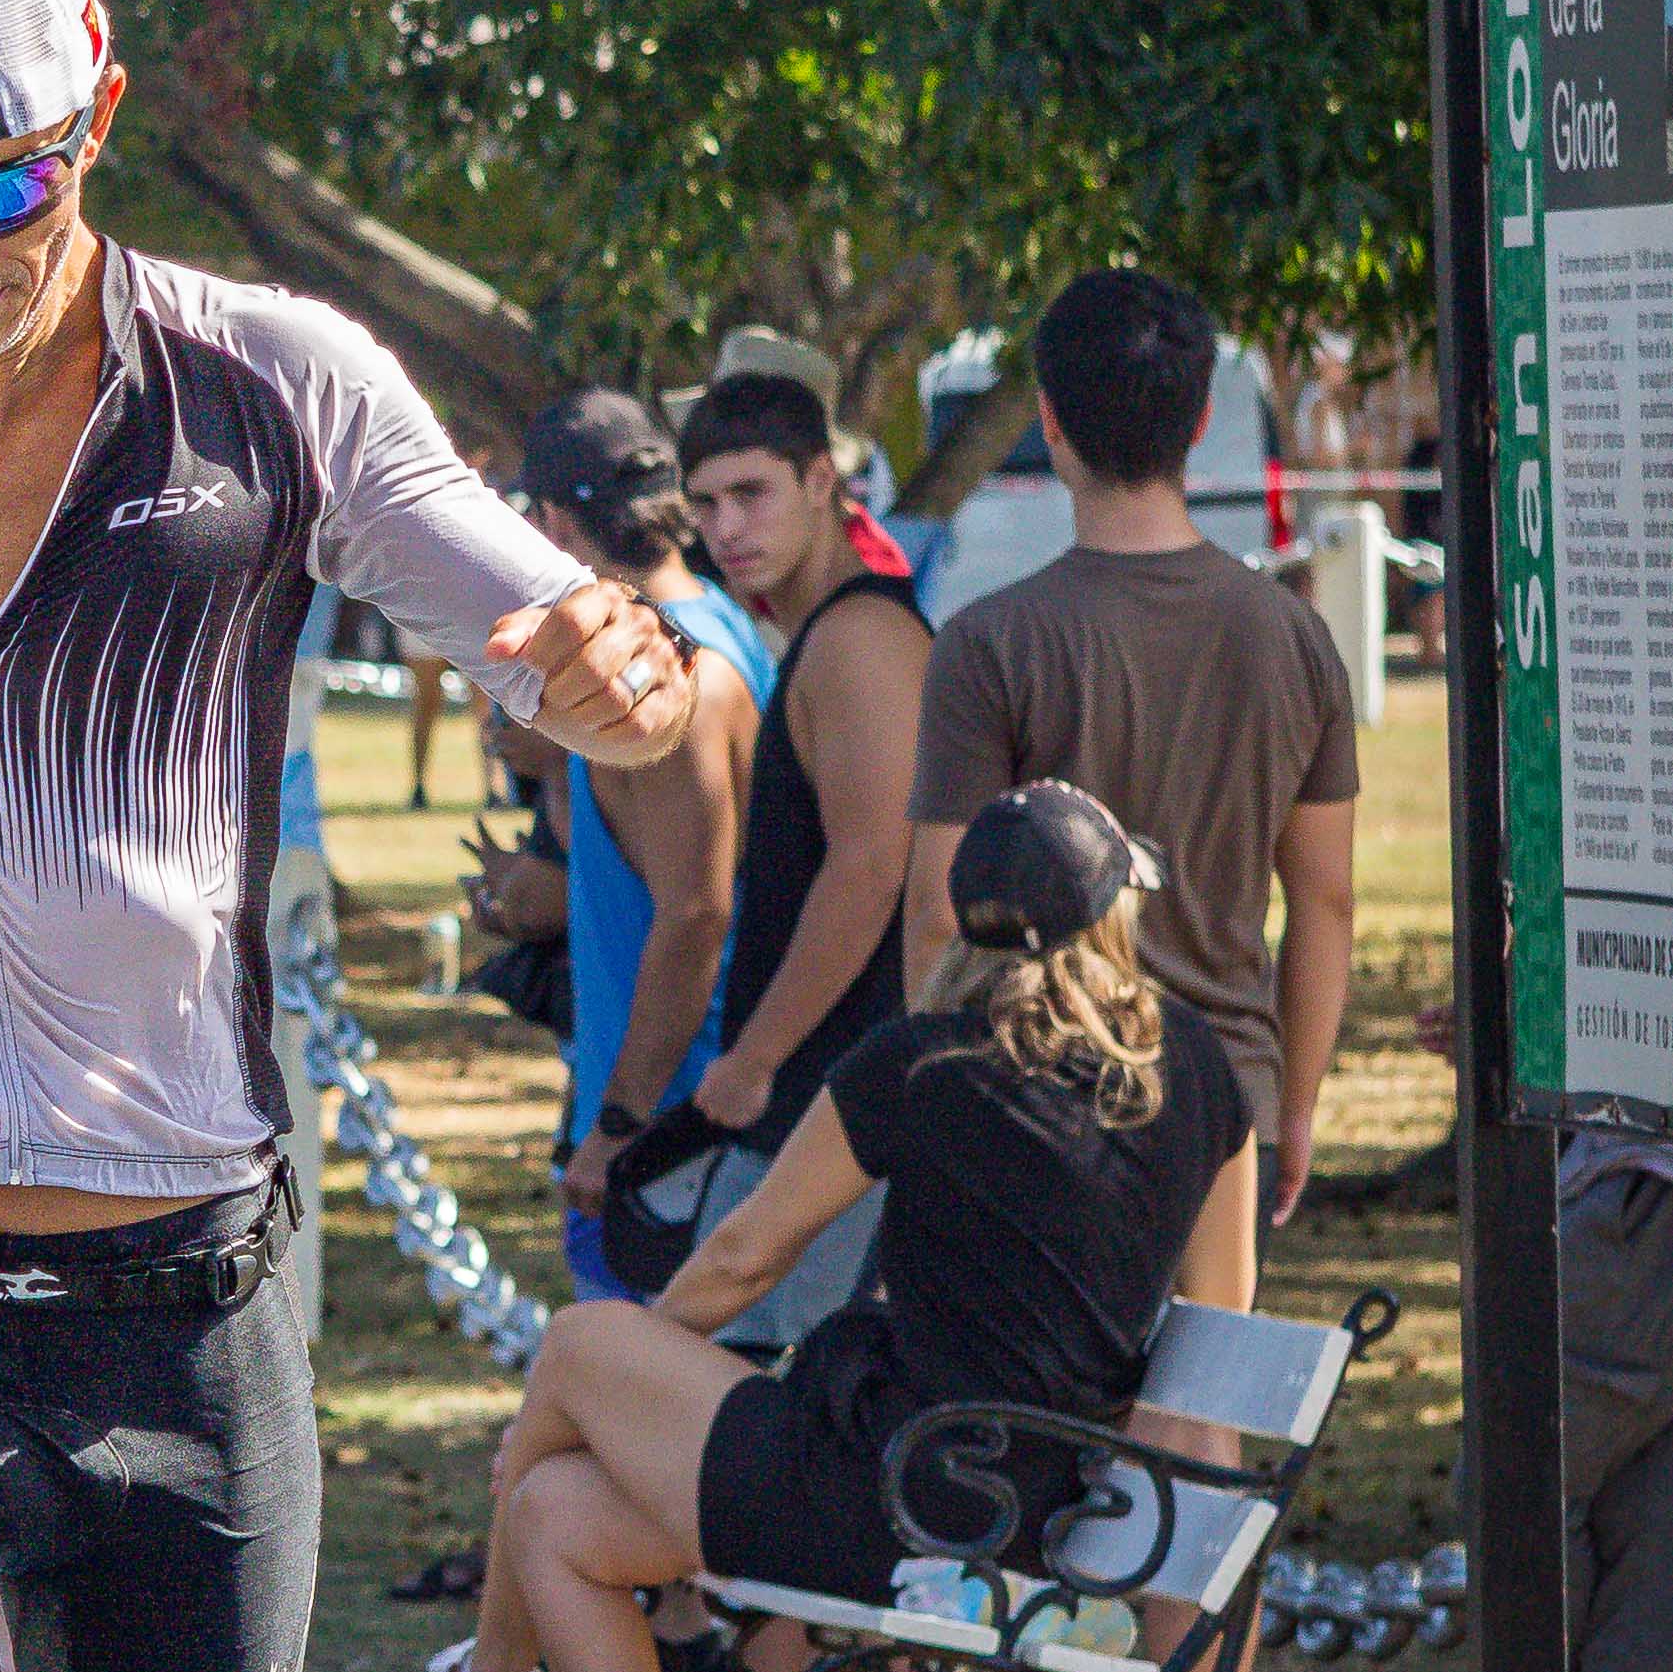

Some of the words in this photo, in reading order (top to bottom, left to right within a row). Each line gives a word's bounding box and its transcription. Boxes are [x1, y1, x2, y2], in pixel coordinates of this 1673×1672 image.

[1552, 78, 1619, 173] Gloria
[109, 481, 226, 530] OSX
[1513, 331, 1547, 671] San
[1576, 929, 1652, 975] MUNICIPALIDAD
[1654, 935, 1666, 977] DE
[1576, 998, 1628, 1039] GESTIÓN
[1635, 1009, 1648, 1045] DE
